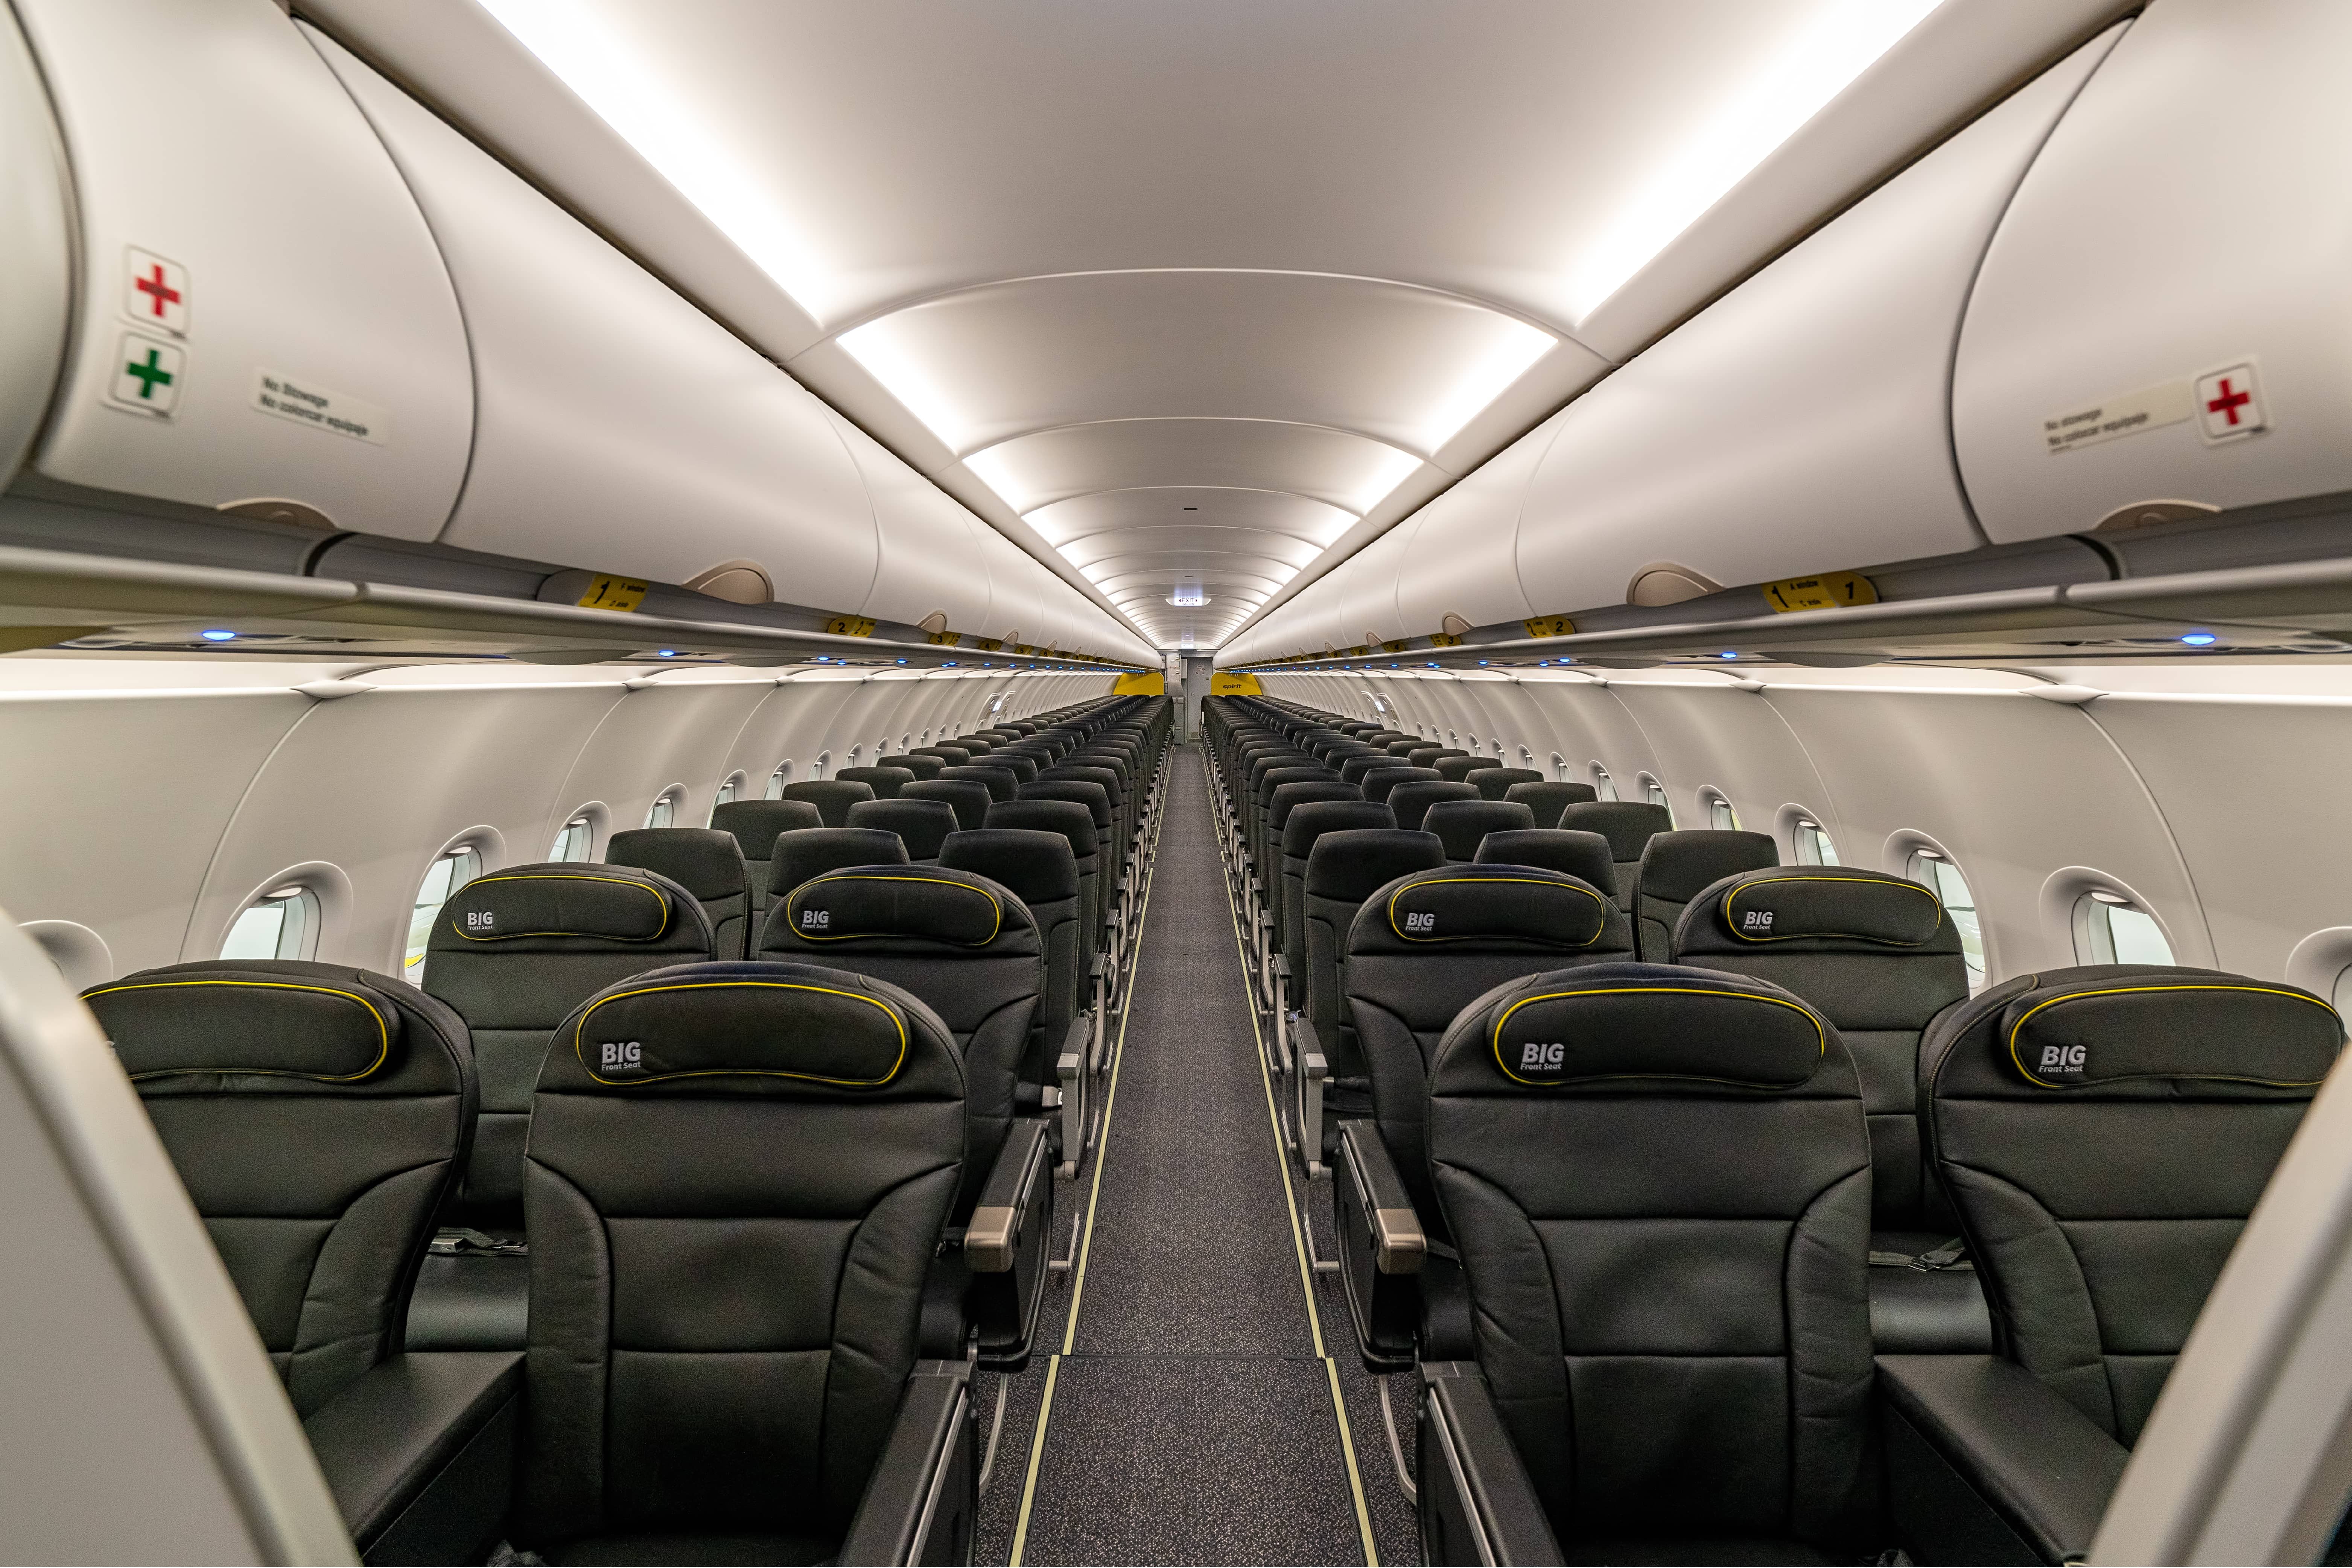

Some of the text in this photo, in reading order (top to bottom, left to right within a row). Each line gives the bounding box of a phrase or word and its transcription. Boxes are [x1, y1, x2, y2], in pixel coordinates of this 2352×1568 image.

[593, 580, 610, 604] 1
[1772, 585, 1789, 608] 1
[1845, 581, 1854, 599] 1
[838, 622, 845, 632] 2
[1556, 621, 1563, 632] 2
[468, 912, 493, 925] BIG
[803, 911, 829, 924] BIG
[1407, 913, 1435, 926] BIG
[1745, 911, 1773, 925] BIG
[602, 1042, 640, 1063] BIG
[1522, 1043, 1564, 1063] BIG
[2041, 1045, 2087, 1066] BIG
